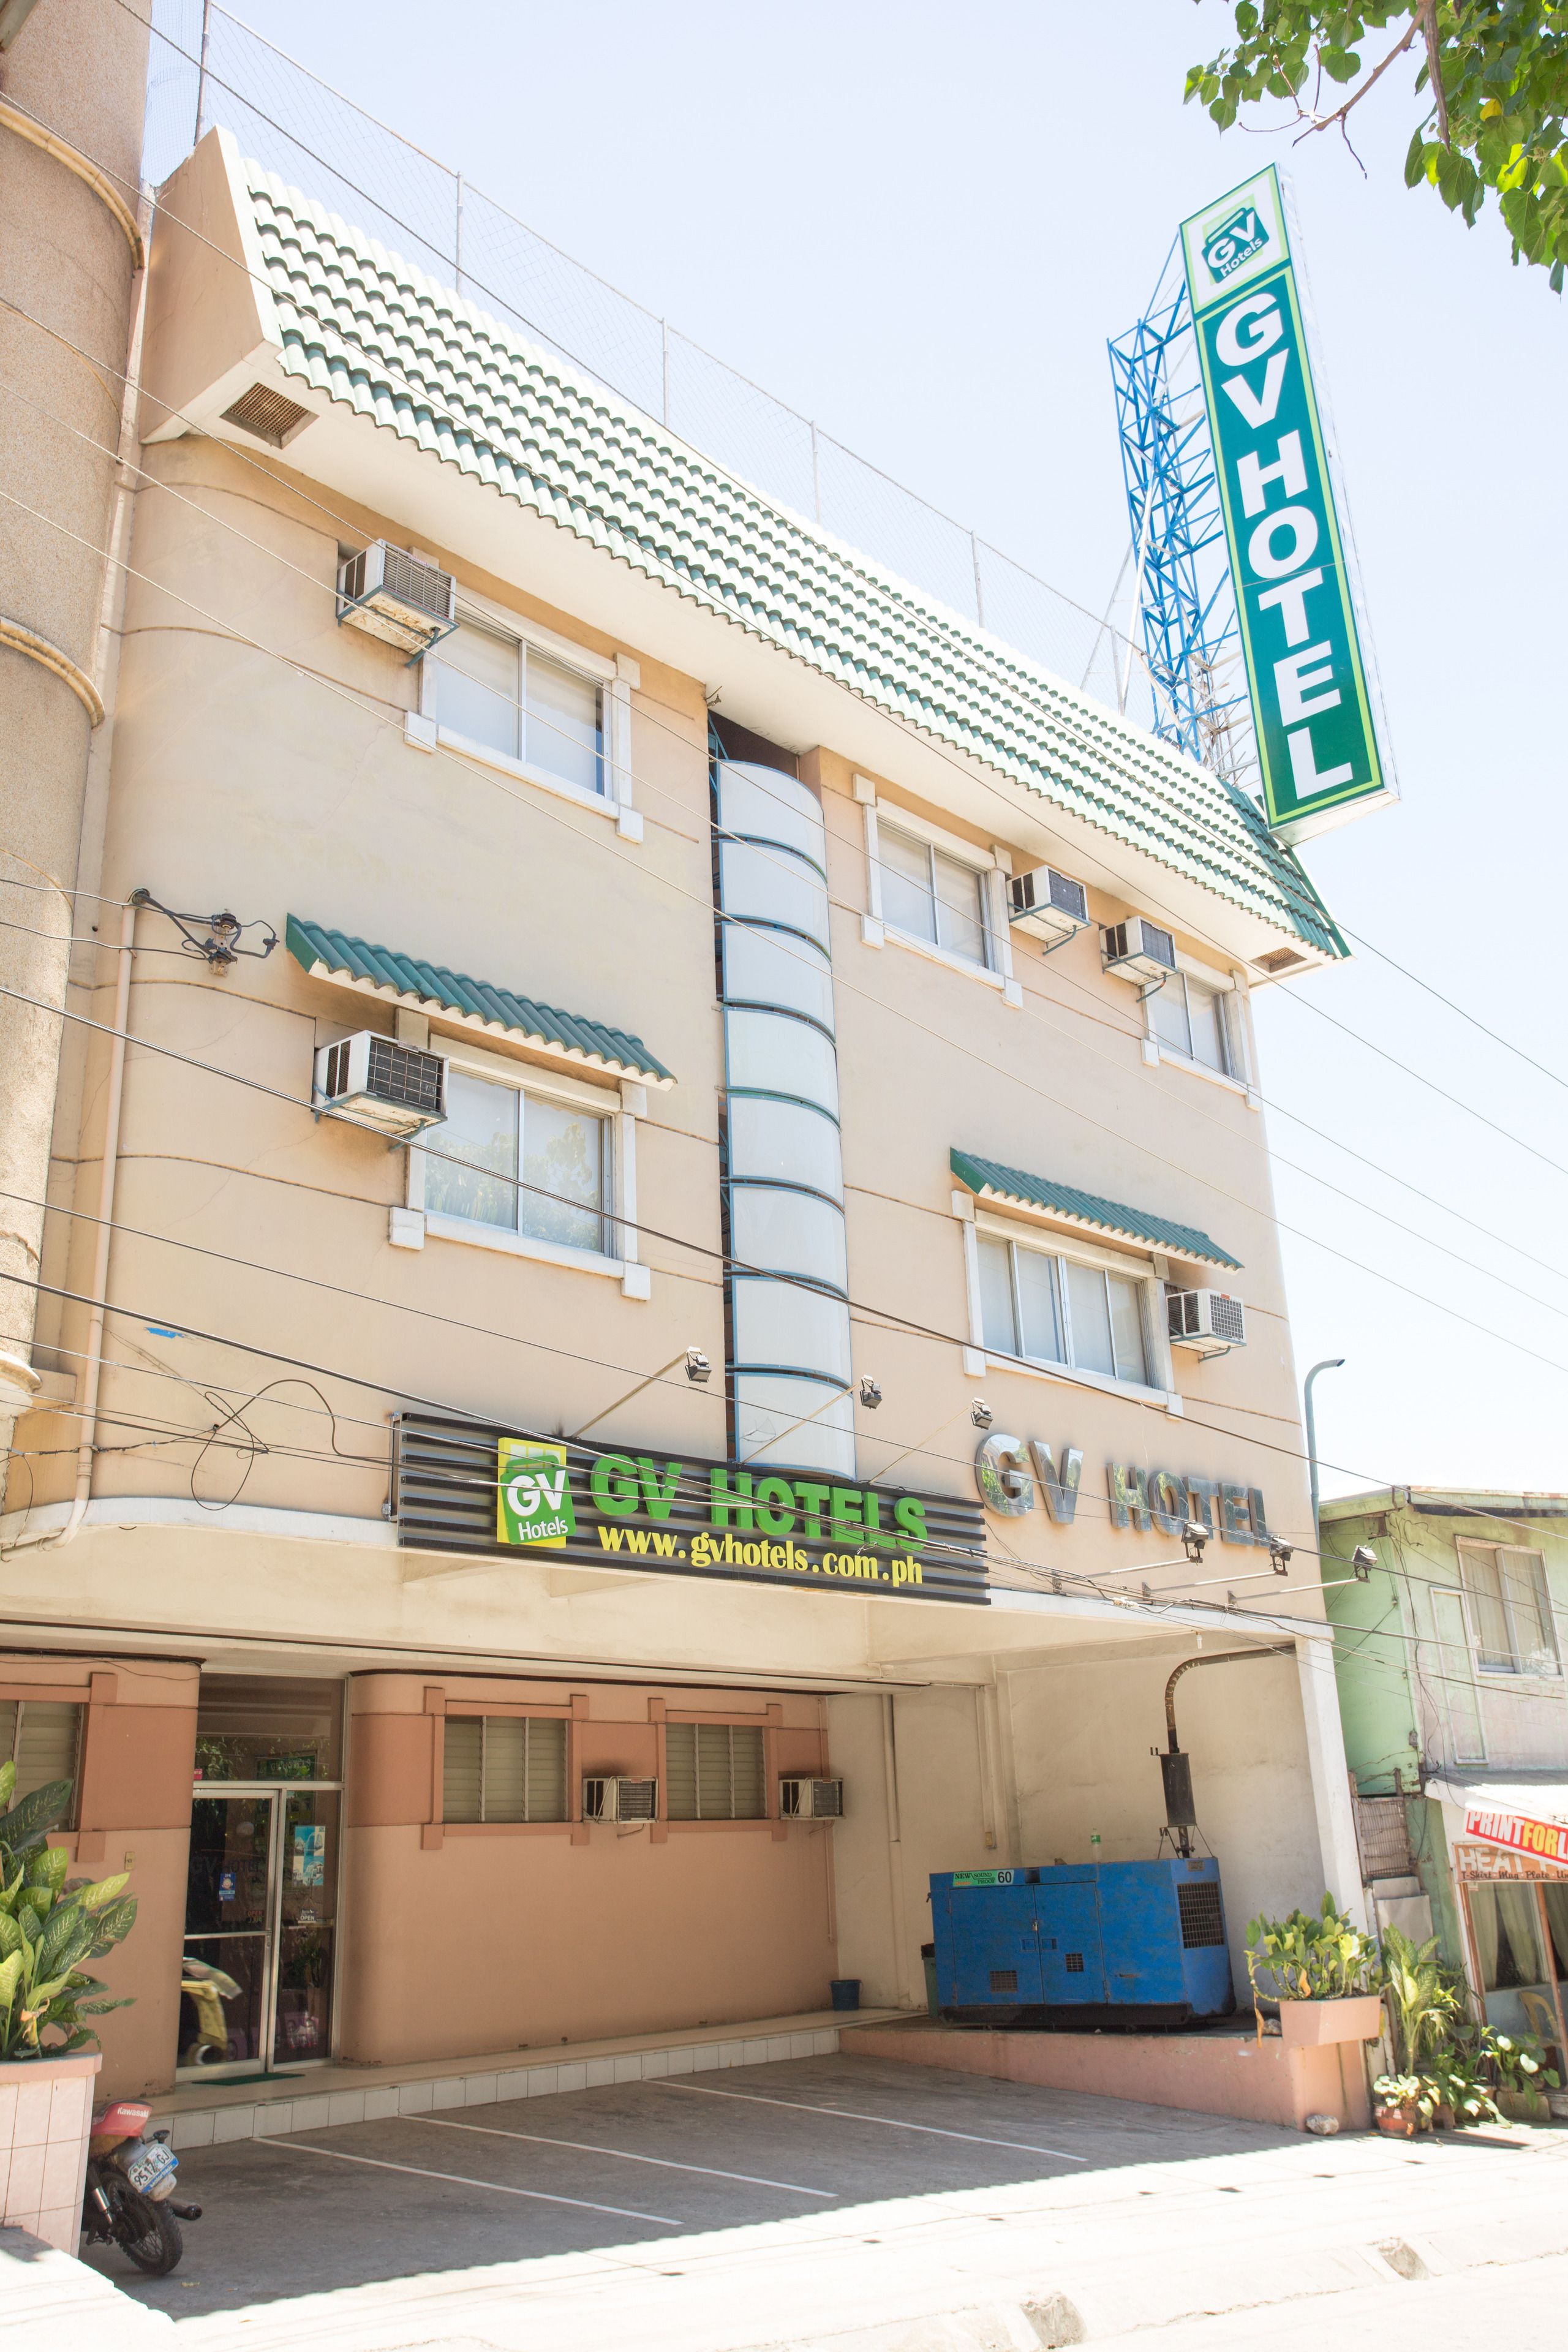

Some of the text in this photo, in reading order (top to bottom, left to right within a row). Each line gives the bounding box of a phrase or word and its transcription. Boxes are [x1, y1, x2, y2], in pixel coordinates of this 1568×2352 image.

[1207, 209, 1256, 268] GV
[1219, 237, 1263, 277] Hotels
[507, 1469, 567, 1517] GV
[590, 1453, 928, 1553] GV HOTELS
[974, 1433, 1272, 1549] GV HOTEL
[518, 1516, 568, 1540] Hotels
[997, 1871, 1012, 1883] 60
[1461, 1870, 1491, 1879] T-Shirt
[1499, 1871, 1519, 1879] Mug
[1525, 1870, 1549, 1879] Plate
[117, 2106, 149, 2117] Kawasaki
